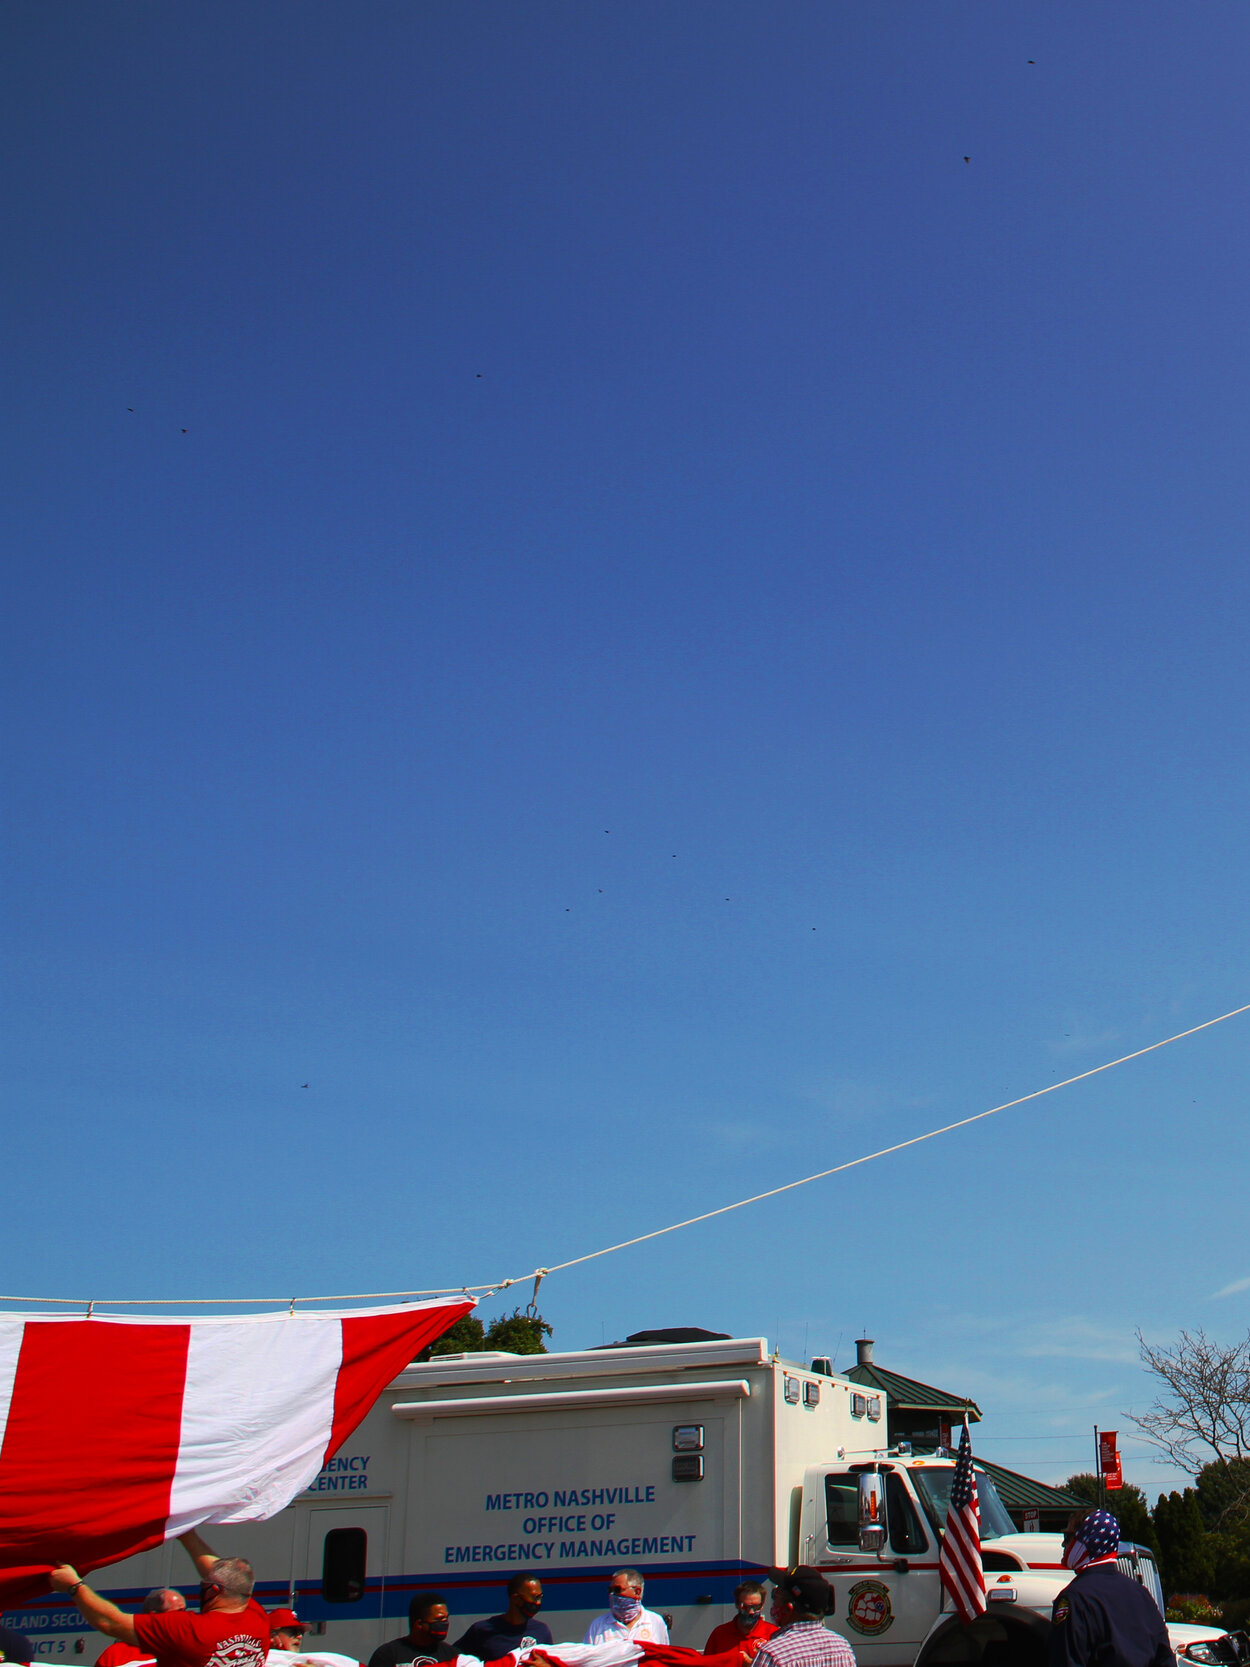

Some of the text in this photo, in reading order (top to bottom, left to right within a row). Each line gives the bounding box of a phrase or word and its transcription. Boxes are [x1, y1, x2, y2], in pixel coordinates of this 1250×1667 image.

[322, 1455, 371, 1472] ENCY
[485, 1485, 656, 1511] METRO NASHVILLE
[522, 1513, 616, 1535] OFFICE OF
[444, 1535, 697, 1564] EMERGENCY MANAGEMENT
[51, 1613, 89, 1627] SECU
[57, 1640, 67, 1653] 5
